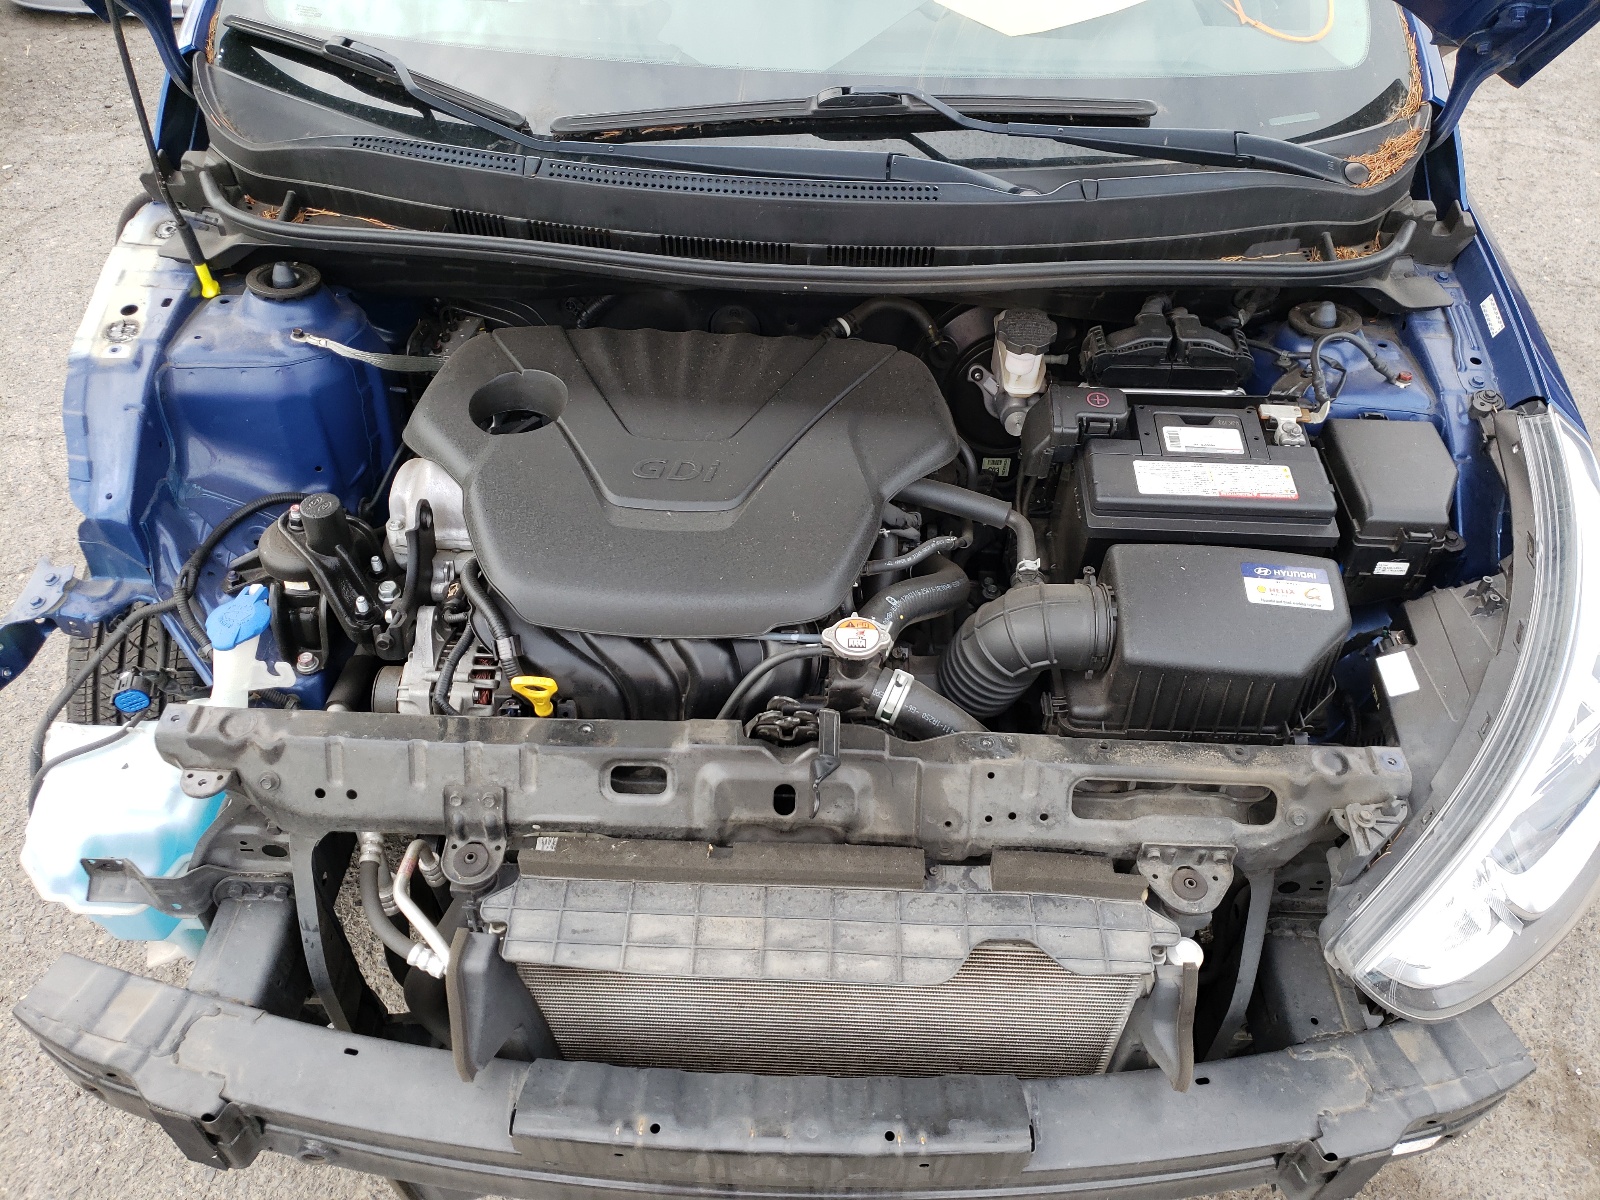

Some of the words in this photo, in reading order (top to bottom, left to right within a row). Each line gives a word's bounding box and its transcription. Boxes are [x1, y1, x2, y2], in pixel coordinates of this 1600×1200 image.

[631, 456, 722, 483] GDi
[1273, 569, 1317, 580] HYUNDAI
[1269, 587, 1295, 595] HELIX
